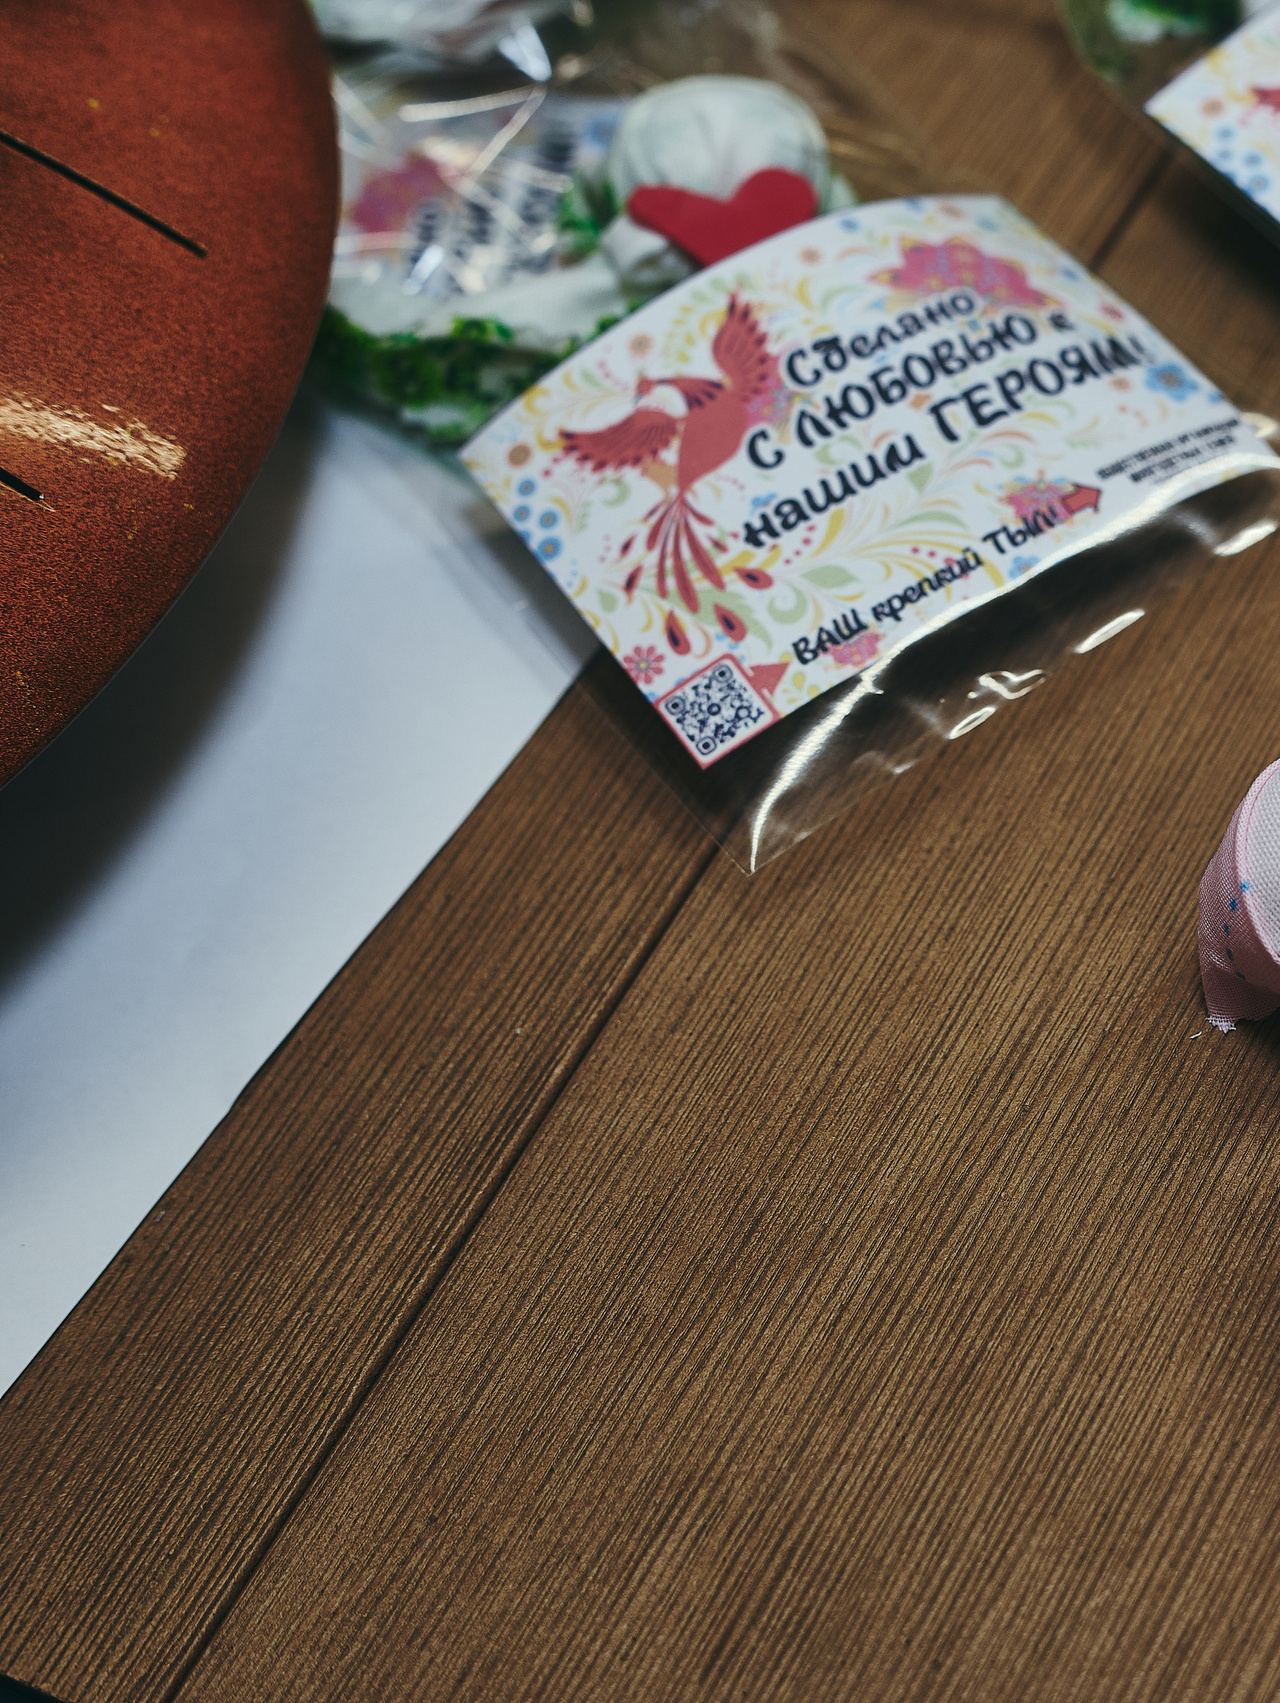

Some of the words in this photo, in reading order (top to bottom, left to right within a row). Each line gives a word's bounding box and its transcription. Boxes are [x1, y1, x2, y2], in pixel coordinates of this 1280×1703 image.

[746, 429, 786, 470] С
[794, 312, 1039, 449] ЛЮБОВЬЮ
[785, 290, 977, 388] Сделано
[742, 433, 927, 548] нашим
[928, 334, 1149, 443] ГЕРОЯМ!
[791, 608, 869, 667] ВАШ
[871, 546, 986, 623] крепкий
[980, 504, 1059, 556] ТЫЛ!
